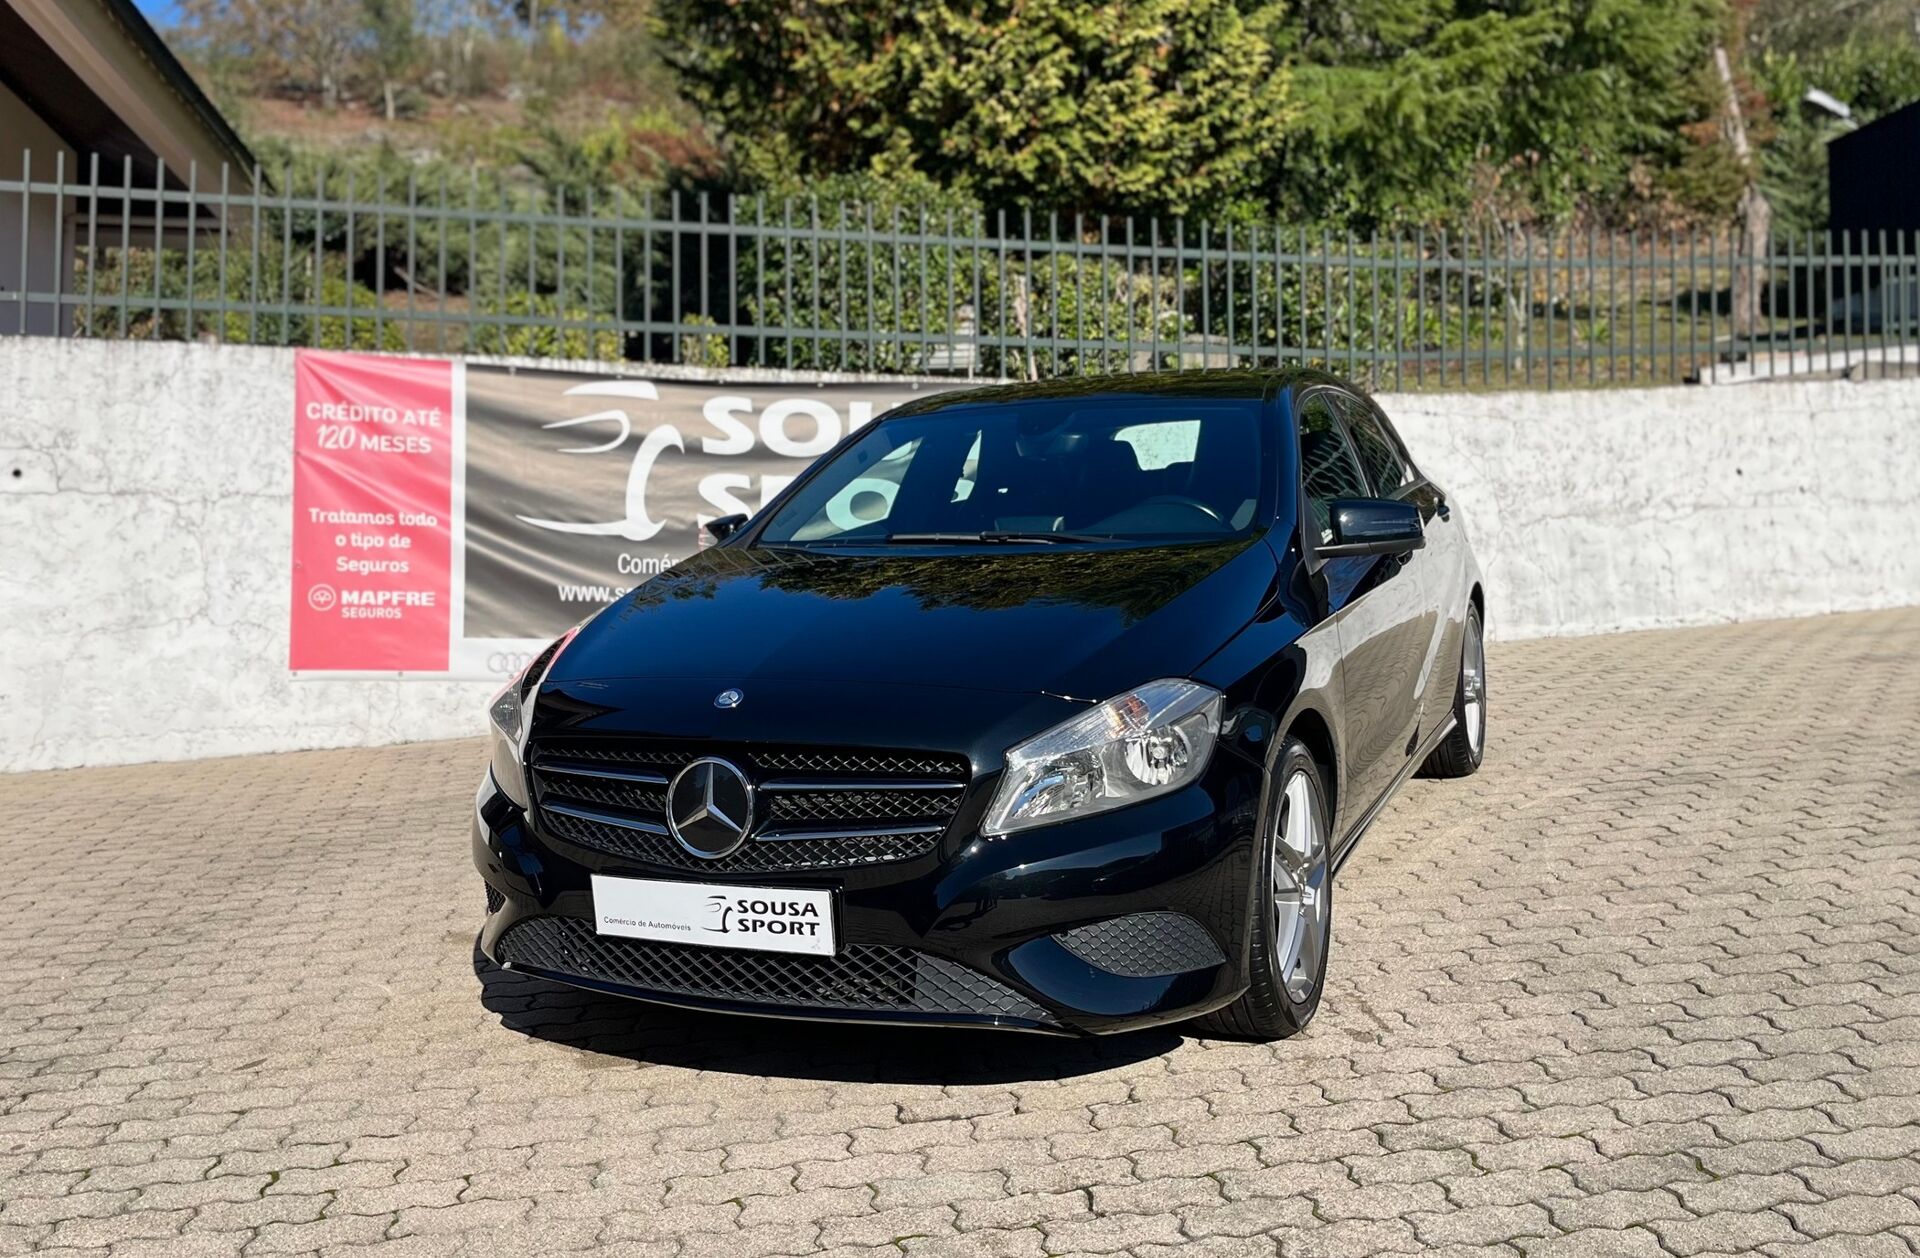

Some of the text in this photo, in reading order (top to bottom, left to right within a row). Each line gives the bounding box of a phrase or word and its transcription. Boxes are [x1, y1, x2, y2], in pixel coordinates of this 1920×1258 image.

[305, 401, 442, 427] CRÉDITO ATÉ
[316, 425, 432, 454] 120 MESES
[308, 507, 438, 527] Tratamos todo
[335, 532, 411, 551] o tipo de
[336, 556, 409, 576] Seguros
[341, 590, 435, 607] MAPFRE
[341, 607, 402, 619] SEGUROS
[737, 899, 819, 917] SOUSA
[603, 916, 692, 932] Comércio de Automóveis
[737, 918, 820, 936] SPORT
